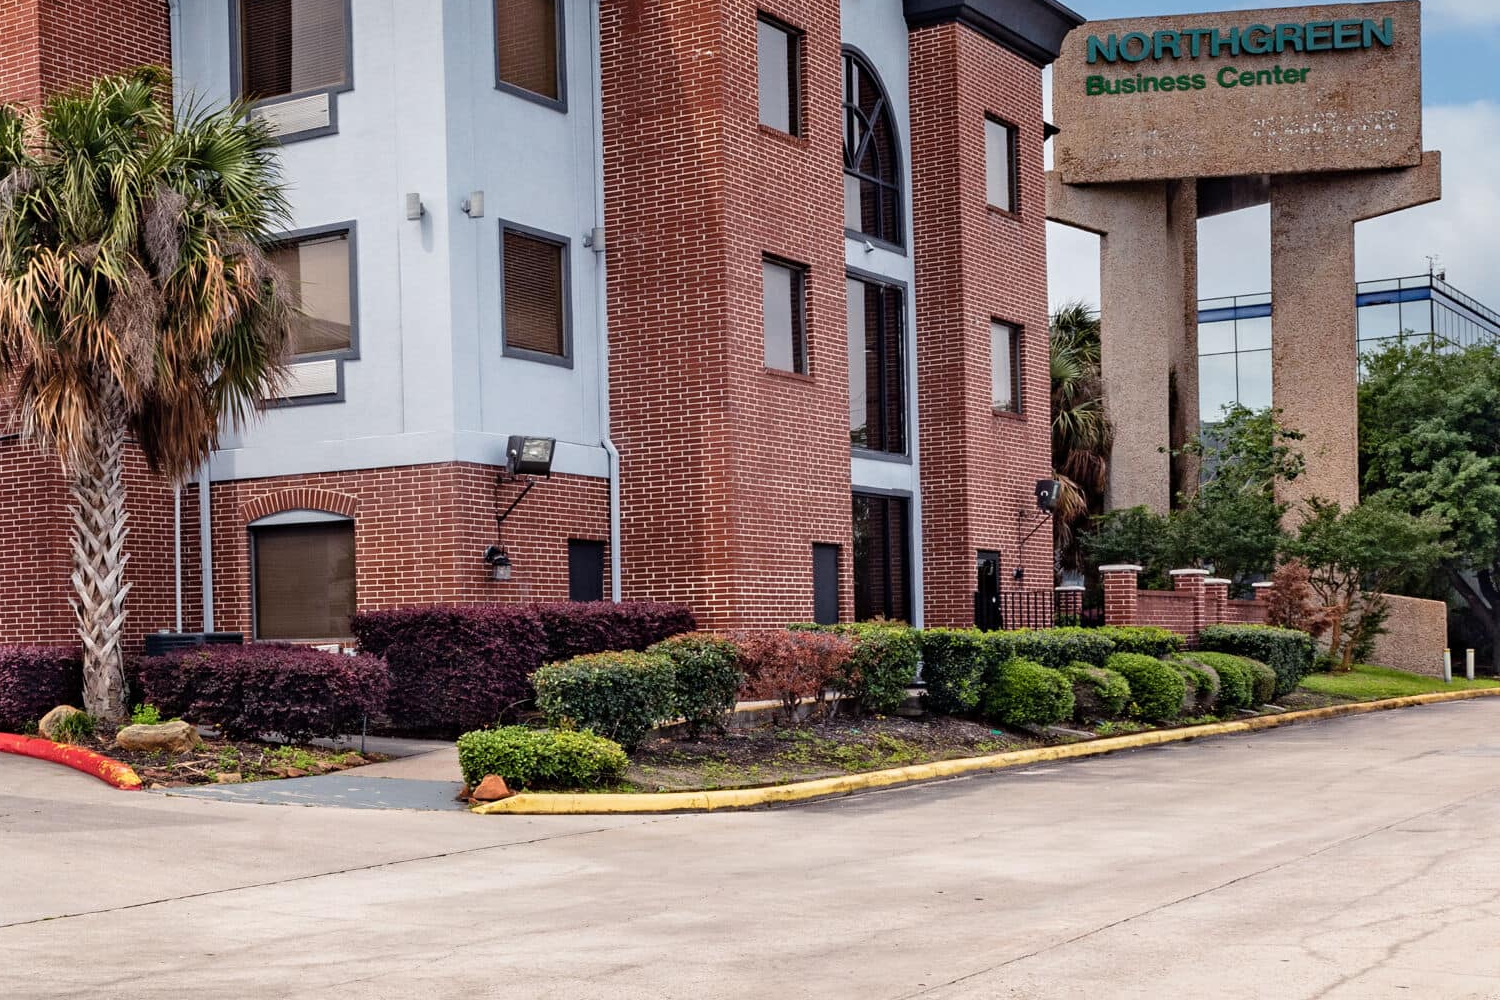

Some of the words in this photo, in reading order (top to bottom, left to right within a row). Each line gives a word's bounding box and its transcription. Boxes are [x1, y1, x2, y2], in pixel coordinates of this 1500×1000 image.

[1086, 17, 1395, 65] NORTHGREEN
[1085, 72, 1207, 97] Business
[1216, 65, 1311, 89] Center
